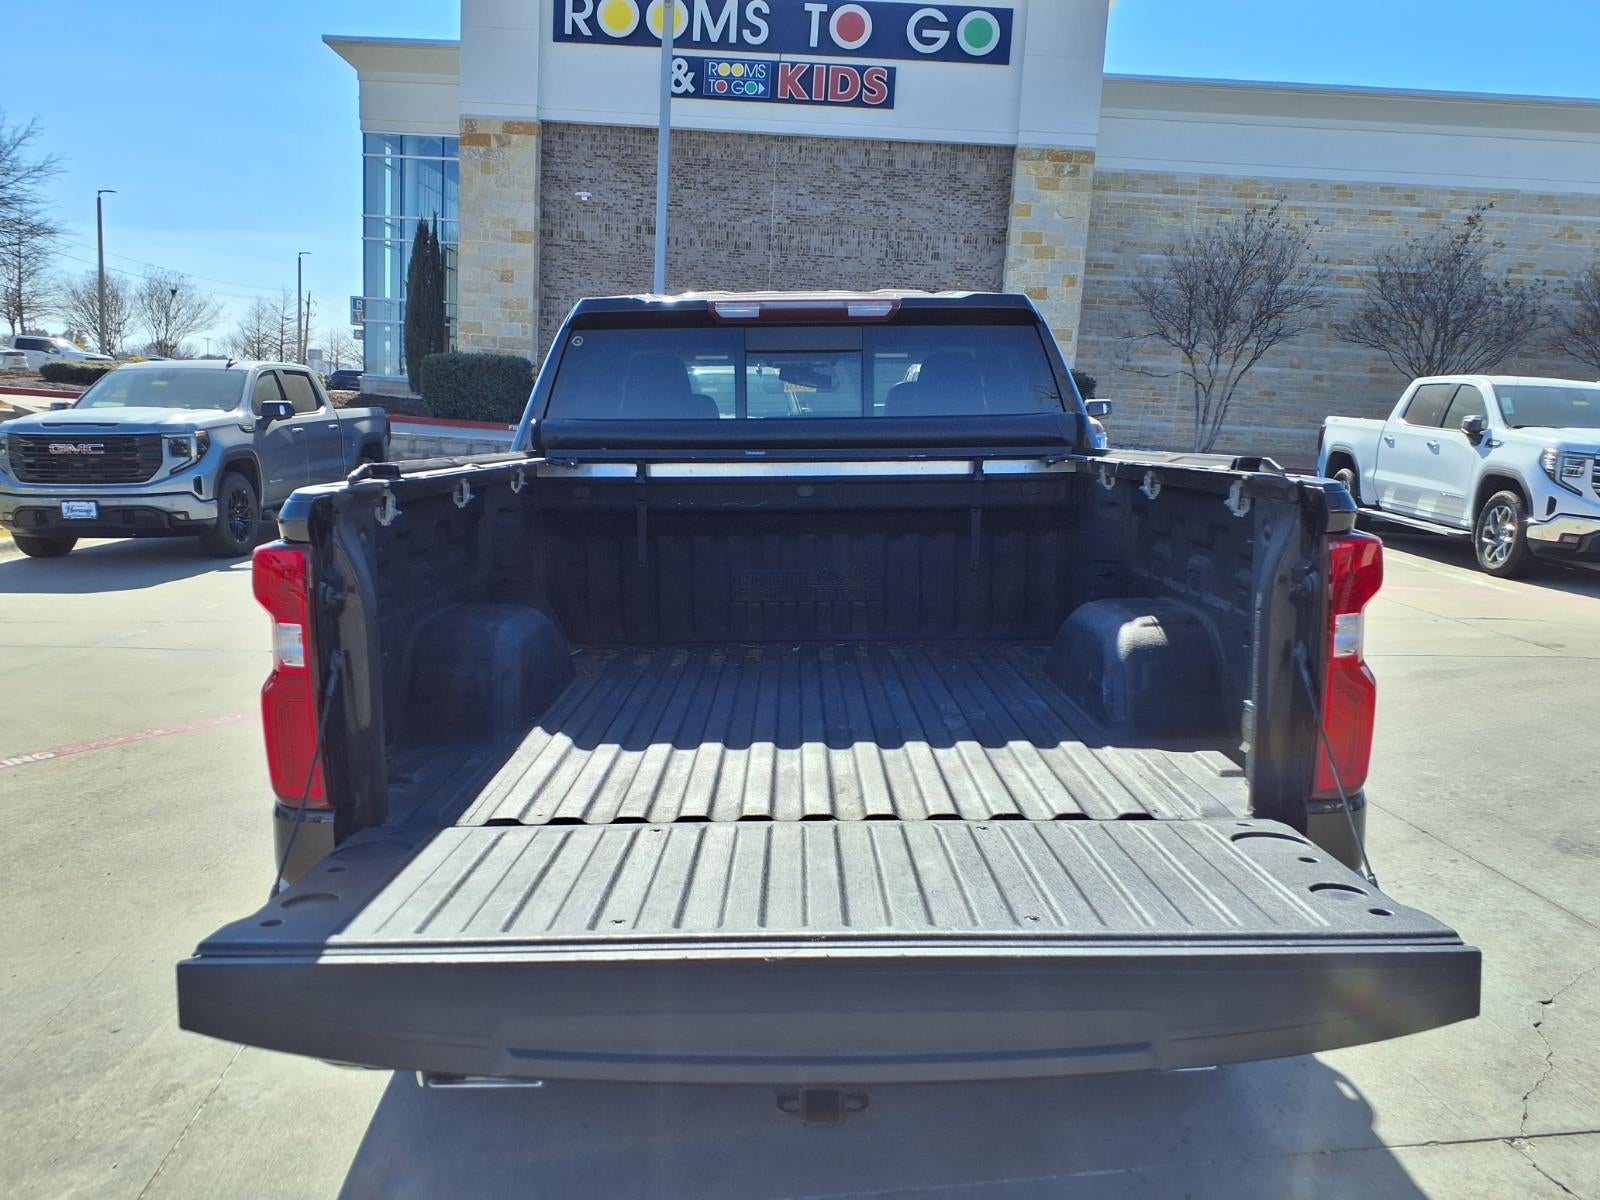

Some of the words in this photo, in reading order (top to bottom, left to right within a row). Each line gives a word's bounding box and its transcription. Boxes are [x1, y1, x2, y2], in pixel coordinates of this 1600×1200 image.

[564, 0, 770, 45] ROOMS
[804, 3, 873, 49] TO
[906, 8, 1001, 56] GO
[671, 57, 696, 94] &
[708, 61, 766, 79] ROOMS
[777, 63, 888, 104] KIDS
[708, 79, 728, 93] TO
[731, 80, 758, 95] GO
[48, 443, 105, 455] GMC
